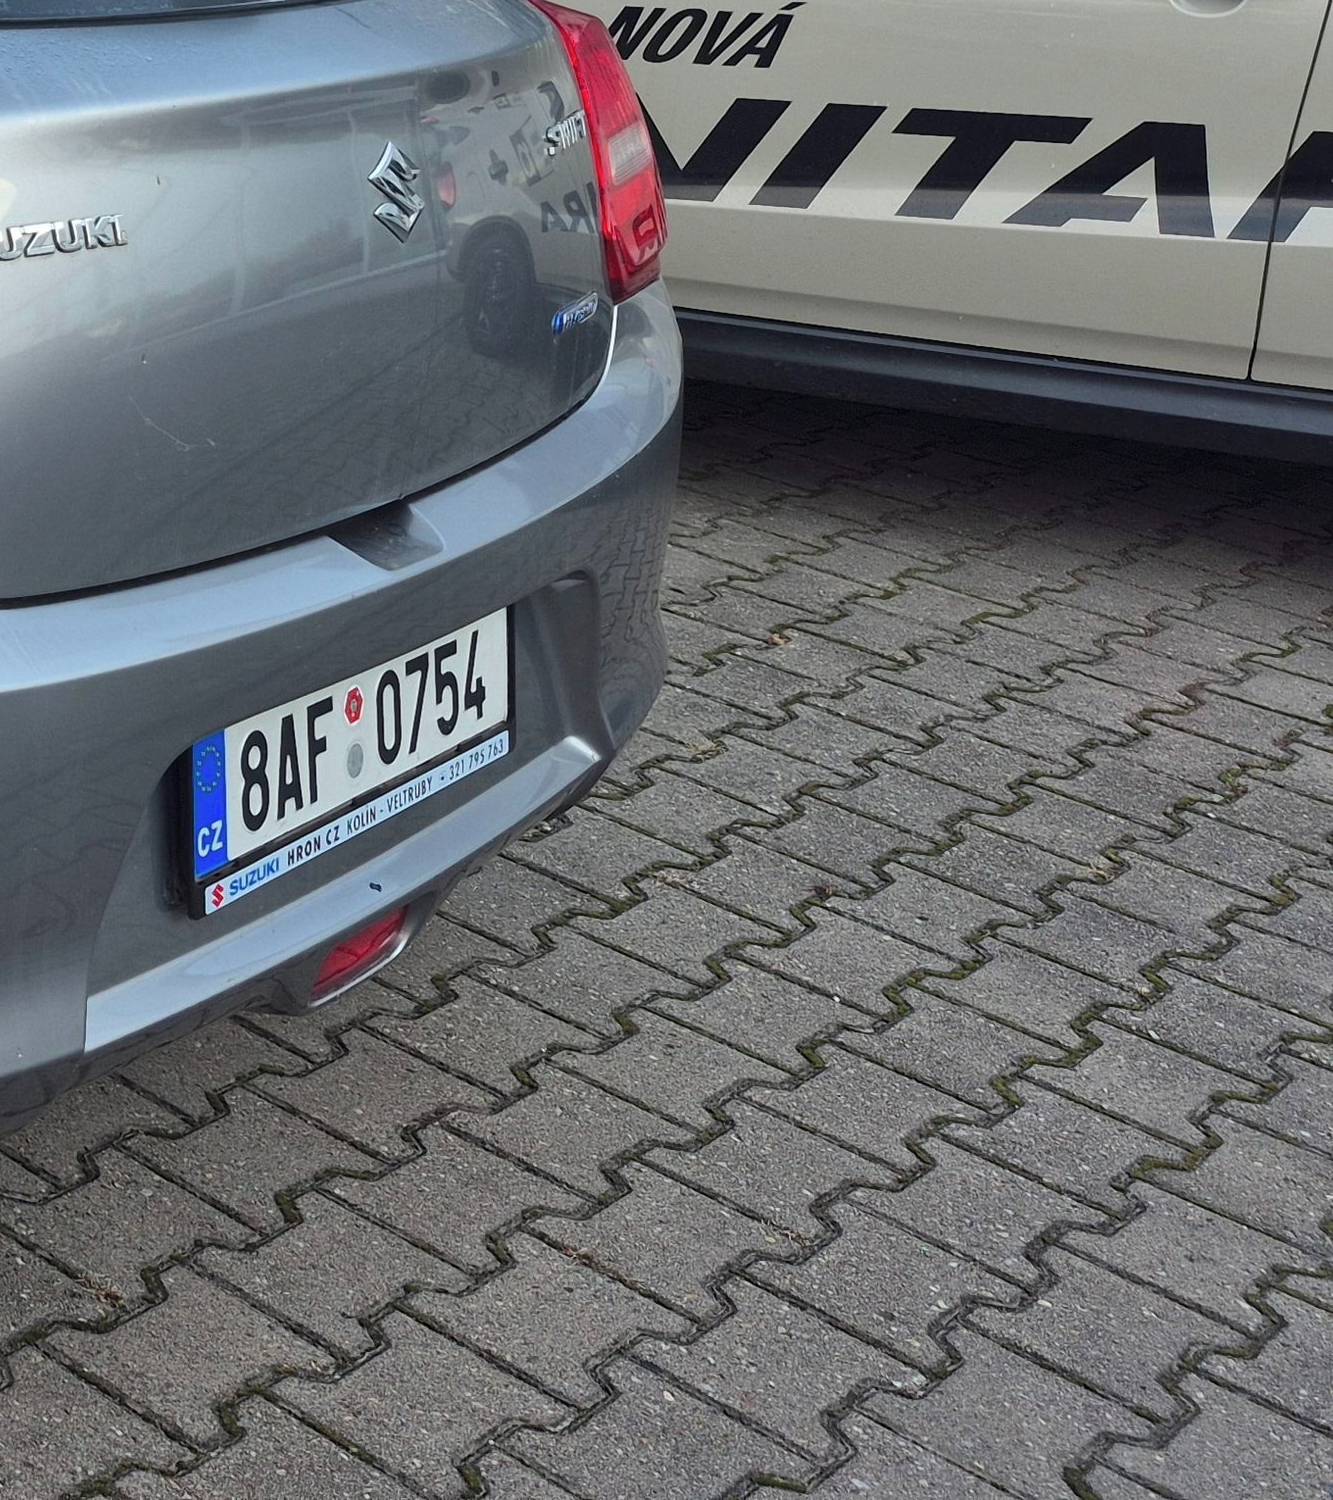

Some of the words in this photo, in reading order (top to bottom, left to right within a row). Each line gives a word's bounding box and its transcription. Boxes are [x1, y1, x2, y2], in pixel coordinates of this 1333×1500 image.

[608, 1, 807, 68] NOVÁ
[241, 696, 333, 831] 8AF
[376, 630, 486, 765] 0754
[197, 820, 223, 858] CZ
[229, 857, 279, 896] SUZUKI
[287, 835, 320, 866] HRON
[326, 826, 340, 845] CZ
[347, 805, 376, 833] KOLÍN
[387, 776, 432, 812] VELTRUBY
[449, 759, 464, 780] 321
[469, 750, 484, 766] 795
[488, 739, 503, 762] 763
